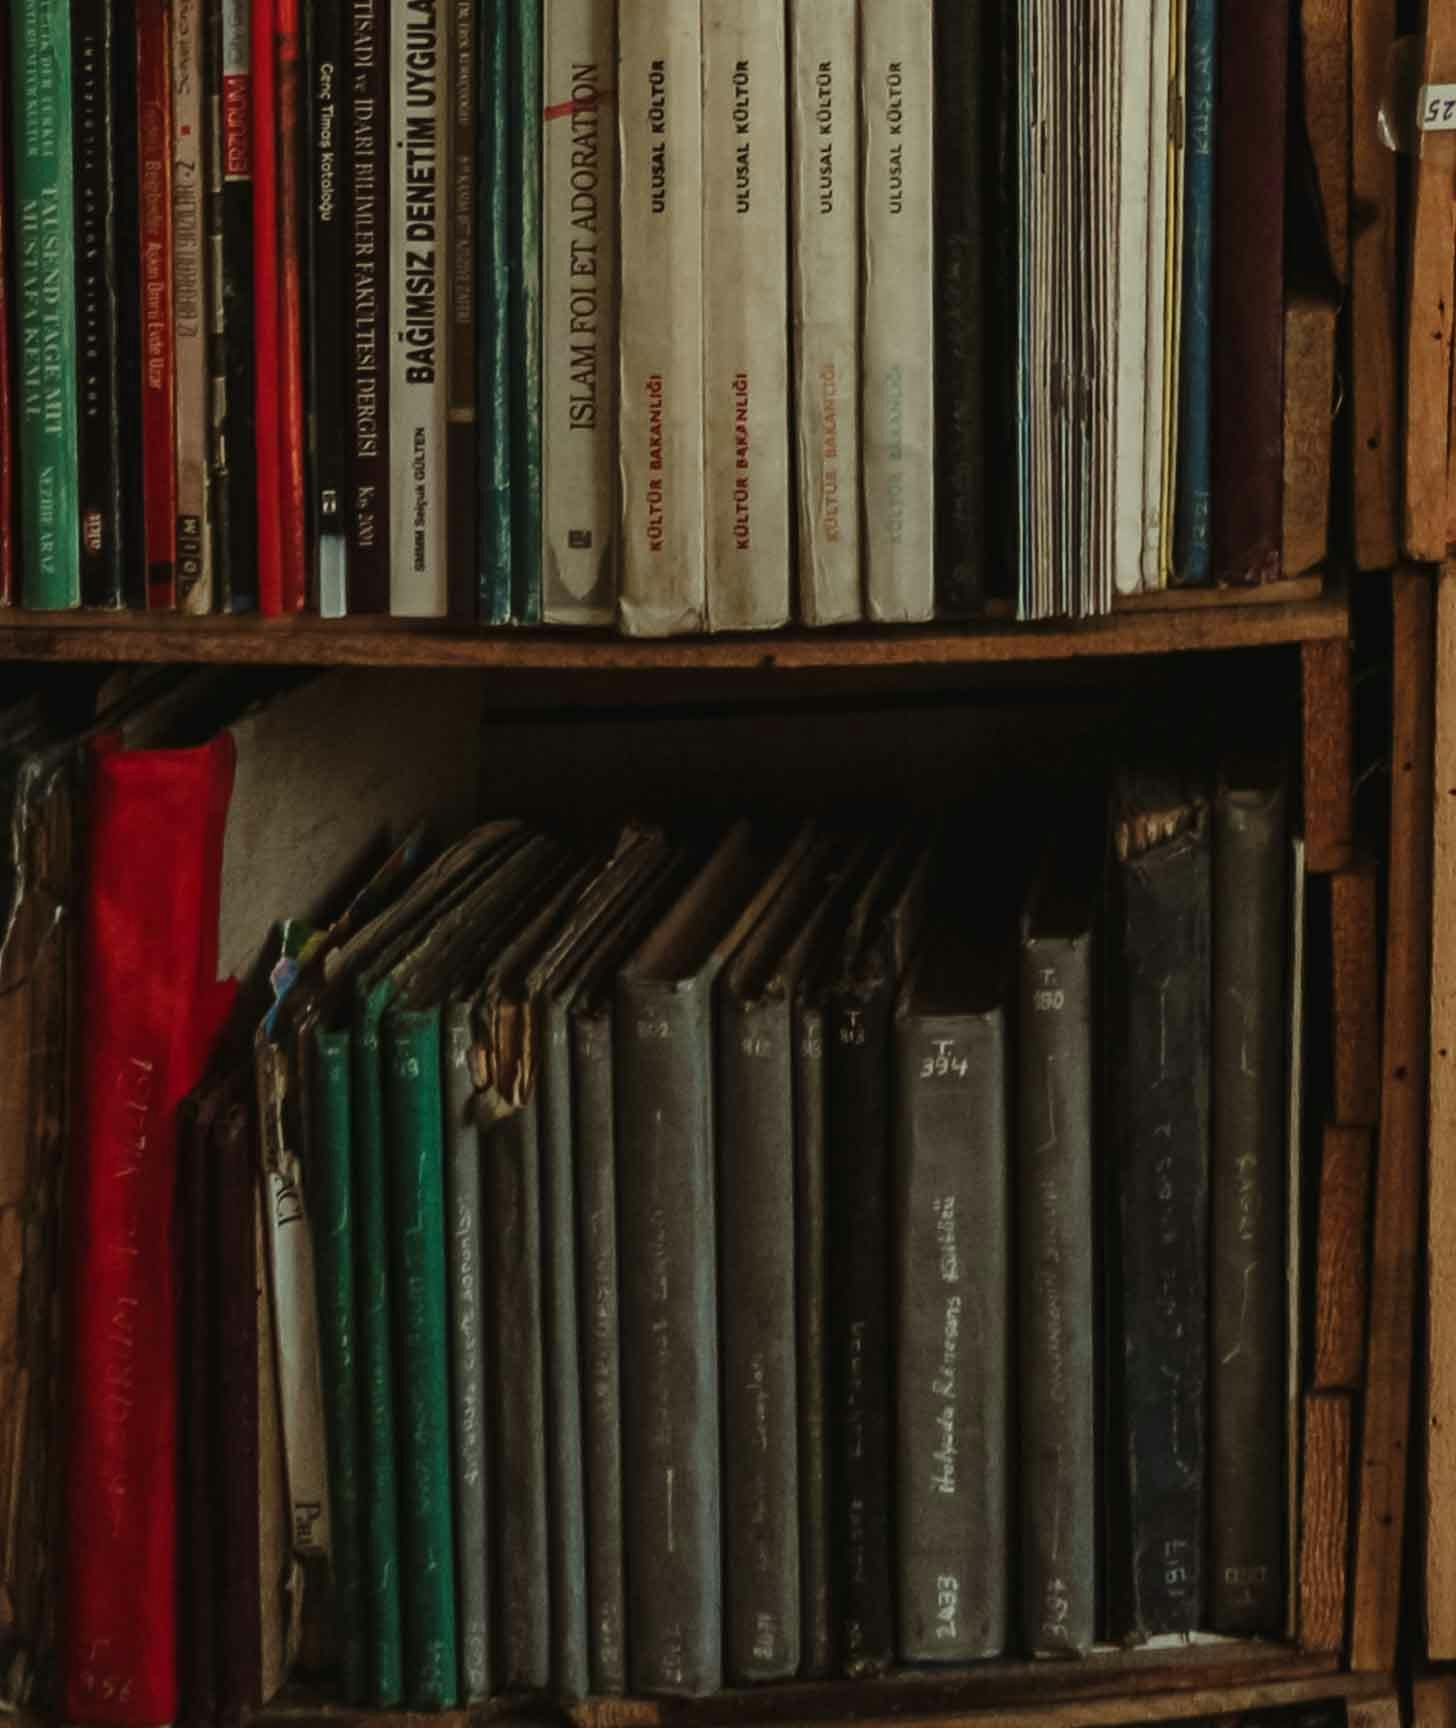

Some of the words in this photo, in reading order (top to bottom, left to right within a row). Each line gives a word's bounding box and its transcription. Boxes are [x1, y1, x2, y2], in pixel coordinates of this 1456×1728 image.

[649, 61, 666, 133] KÜLTÜR
[397, 118, 438, 242] DENETİM
[570, 64, 600, 233] ADORATION
[650, 144, 666, 213] ULUSAL
[570, 241, 598, 276] ET
[395, 251, 439, 384] BAĞIMSIZ
[570, 285, 598, 334] FOI
[569, 343, 598, 431] ISLAM
